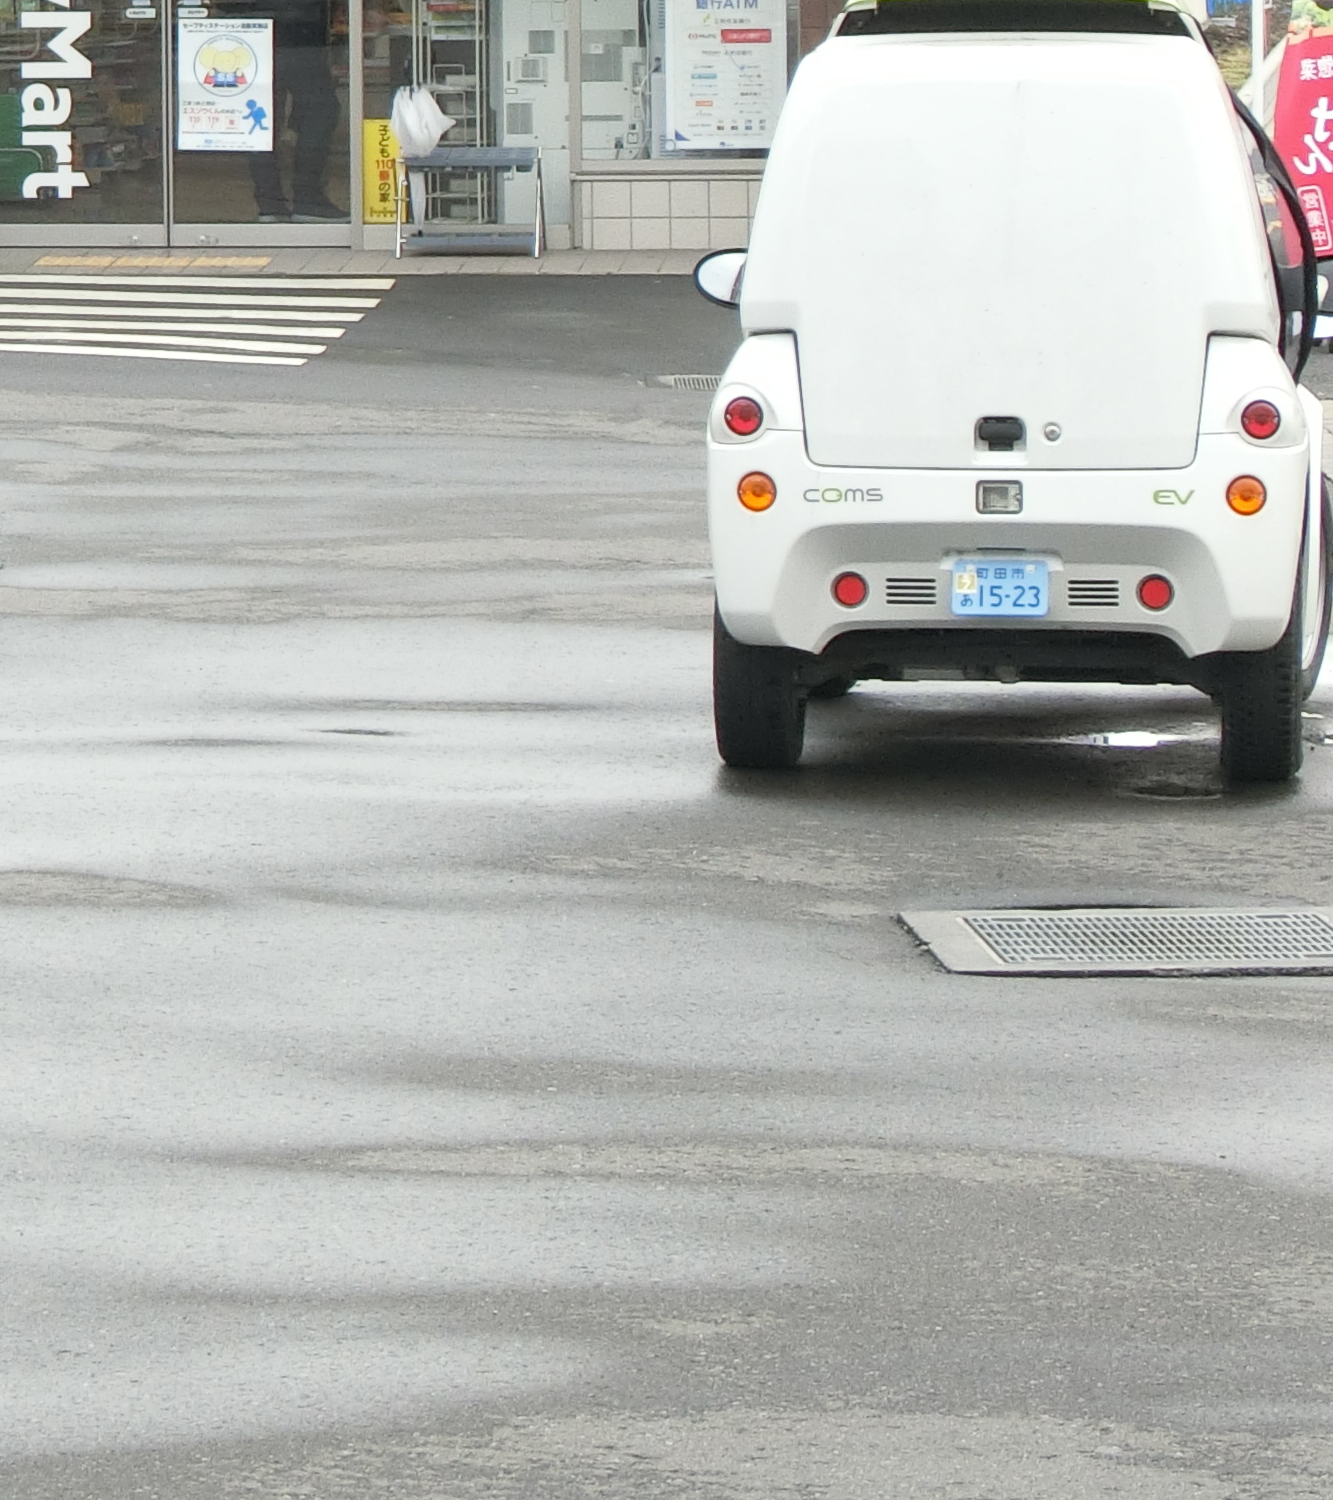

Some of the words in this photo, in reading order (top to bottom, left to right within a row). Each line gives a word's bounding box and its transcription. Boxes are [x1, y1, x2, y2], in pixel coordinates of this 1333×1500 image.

[1152, 489, 1195, 506] EV
[976, 567, 1025, 580] 町田市
[960, 593, 974, 608] あ
[978, 584, 1041, 608] 15-23
